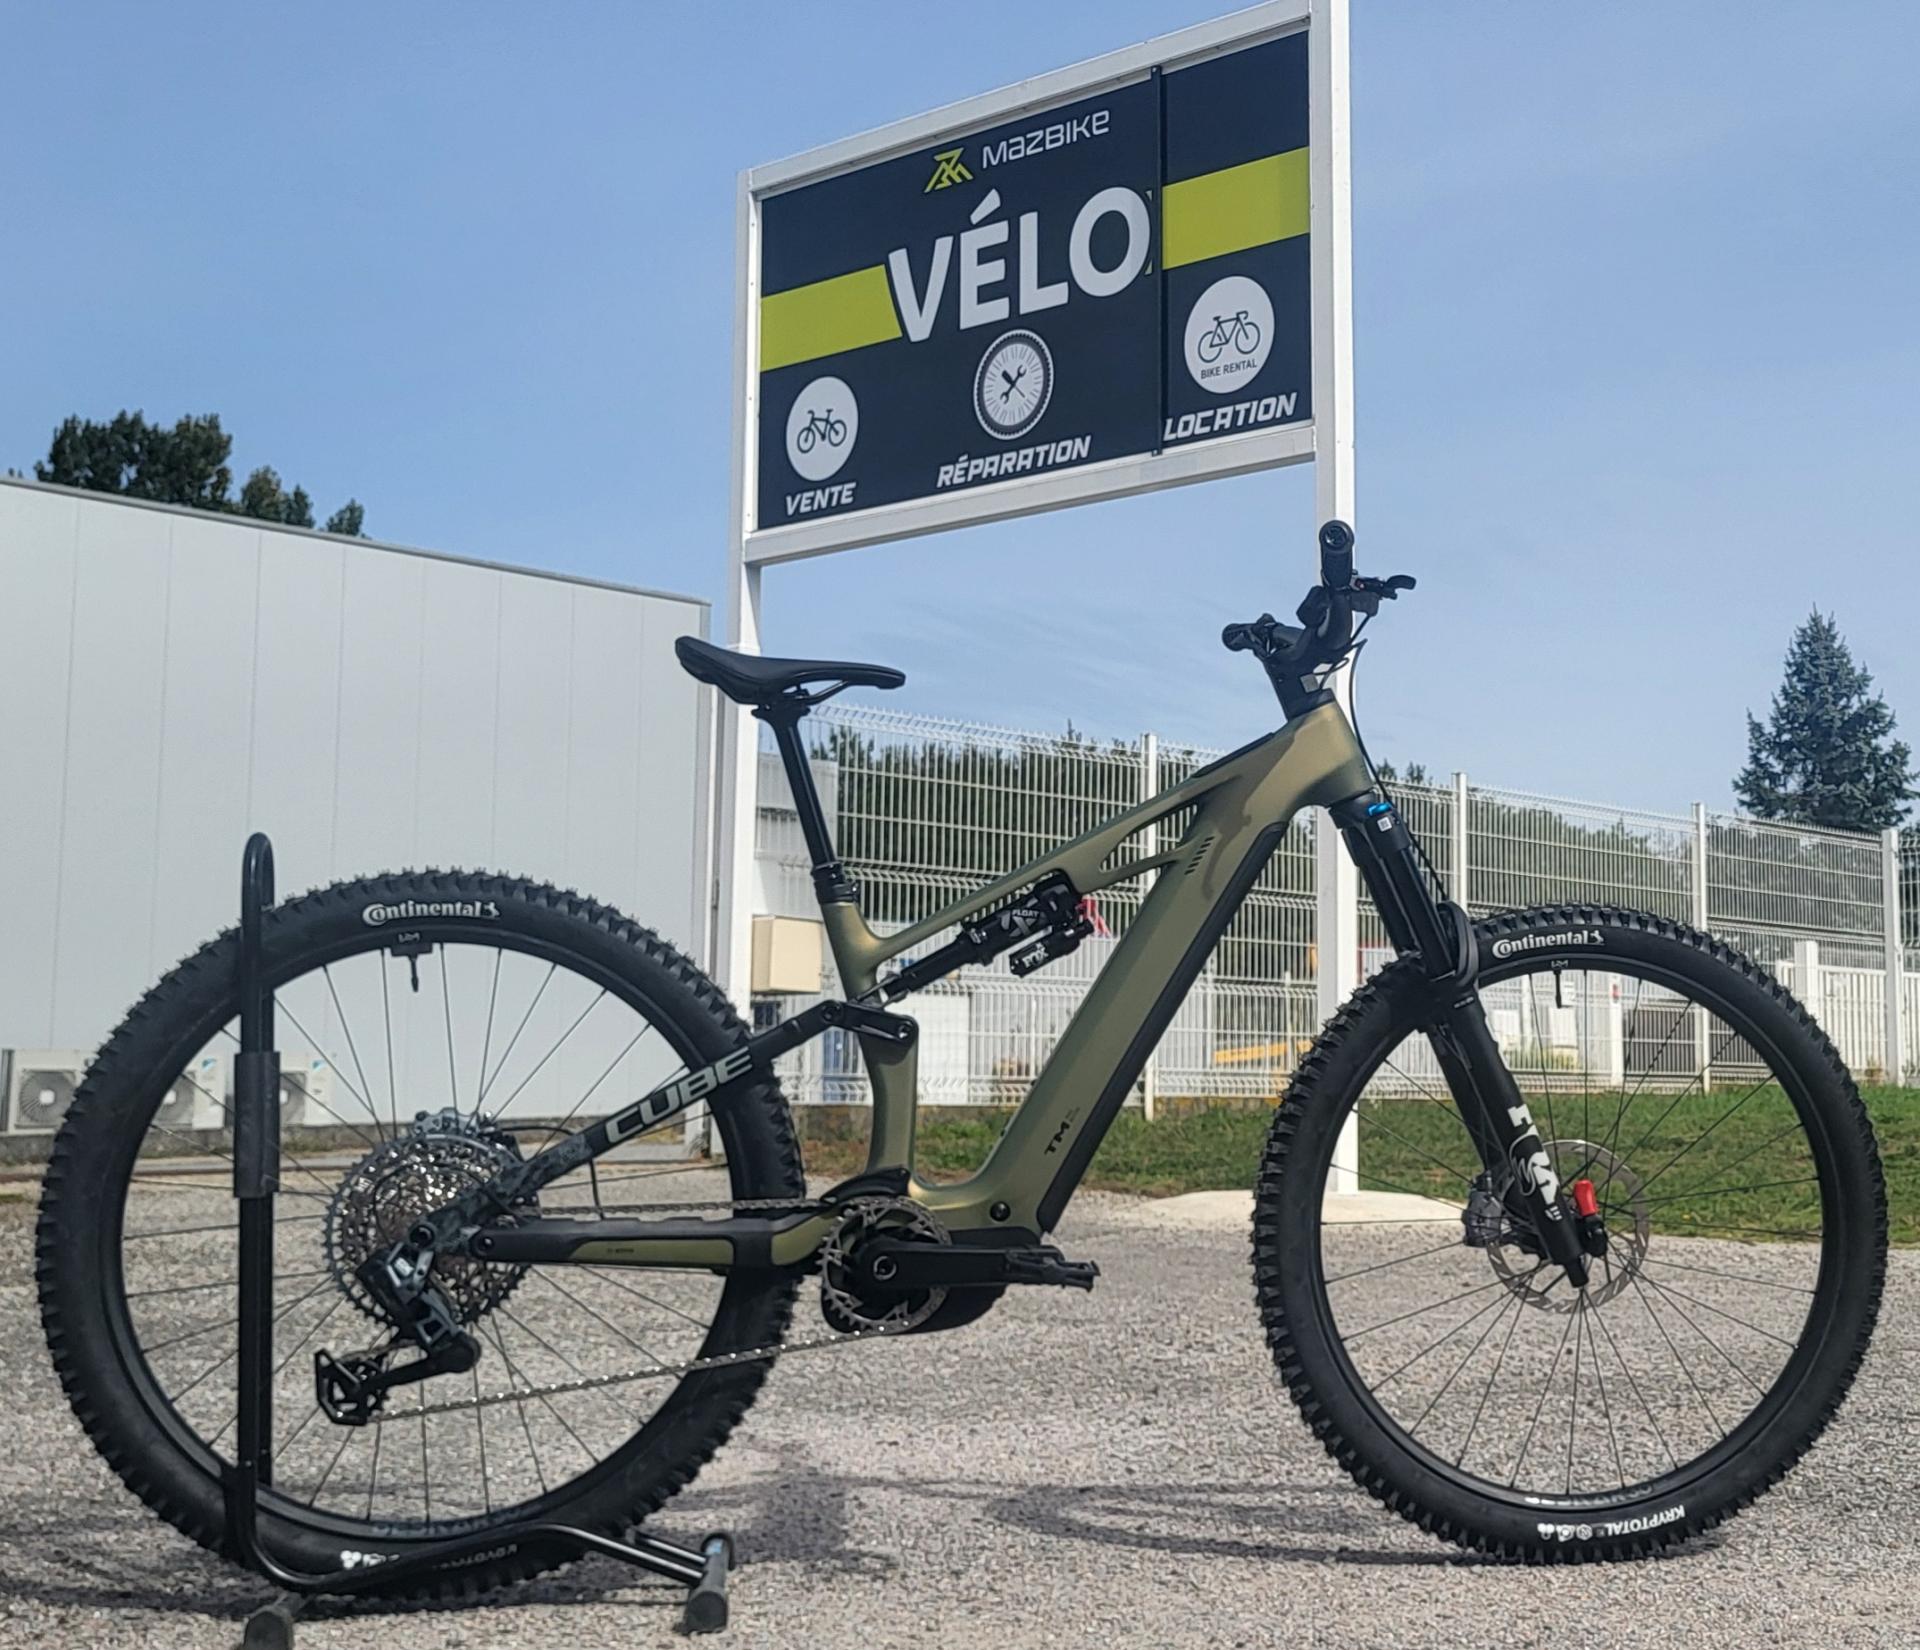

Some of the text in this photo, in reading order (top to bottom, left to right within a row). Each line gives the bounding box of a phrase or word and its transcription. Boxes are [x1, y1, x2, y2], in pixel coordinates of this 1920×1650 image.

[888, 188, 1151, 343] VÉLO
[1201, 359, 1257, 380] BIKE RENTAL
[1164, 392, 1298, 441] LOCATION
[936, 435, 1091, 488] RÉPARATION
[785, 482, 857, 516] VENTE
[362, 900, 482, 926] Continental
[1492, 930, 1588, 959] Continental
[605, 1046, 752, 1144] CUBE
[1604, 1504, 1685, 1537] KRYPTOTAL
